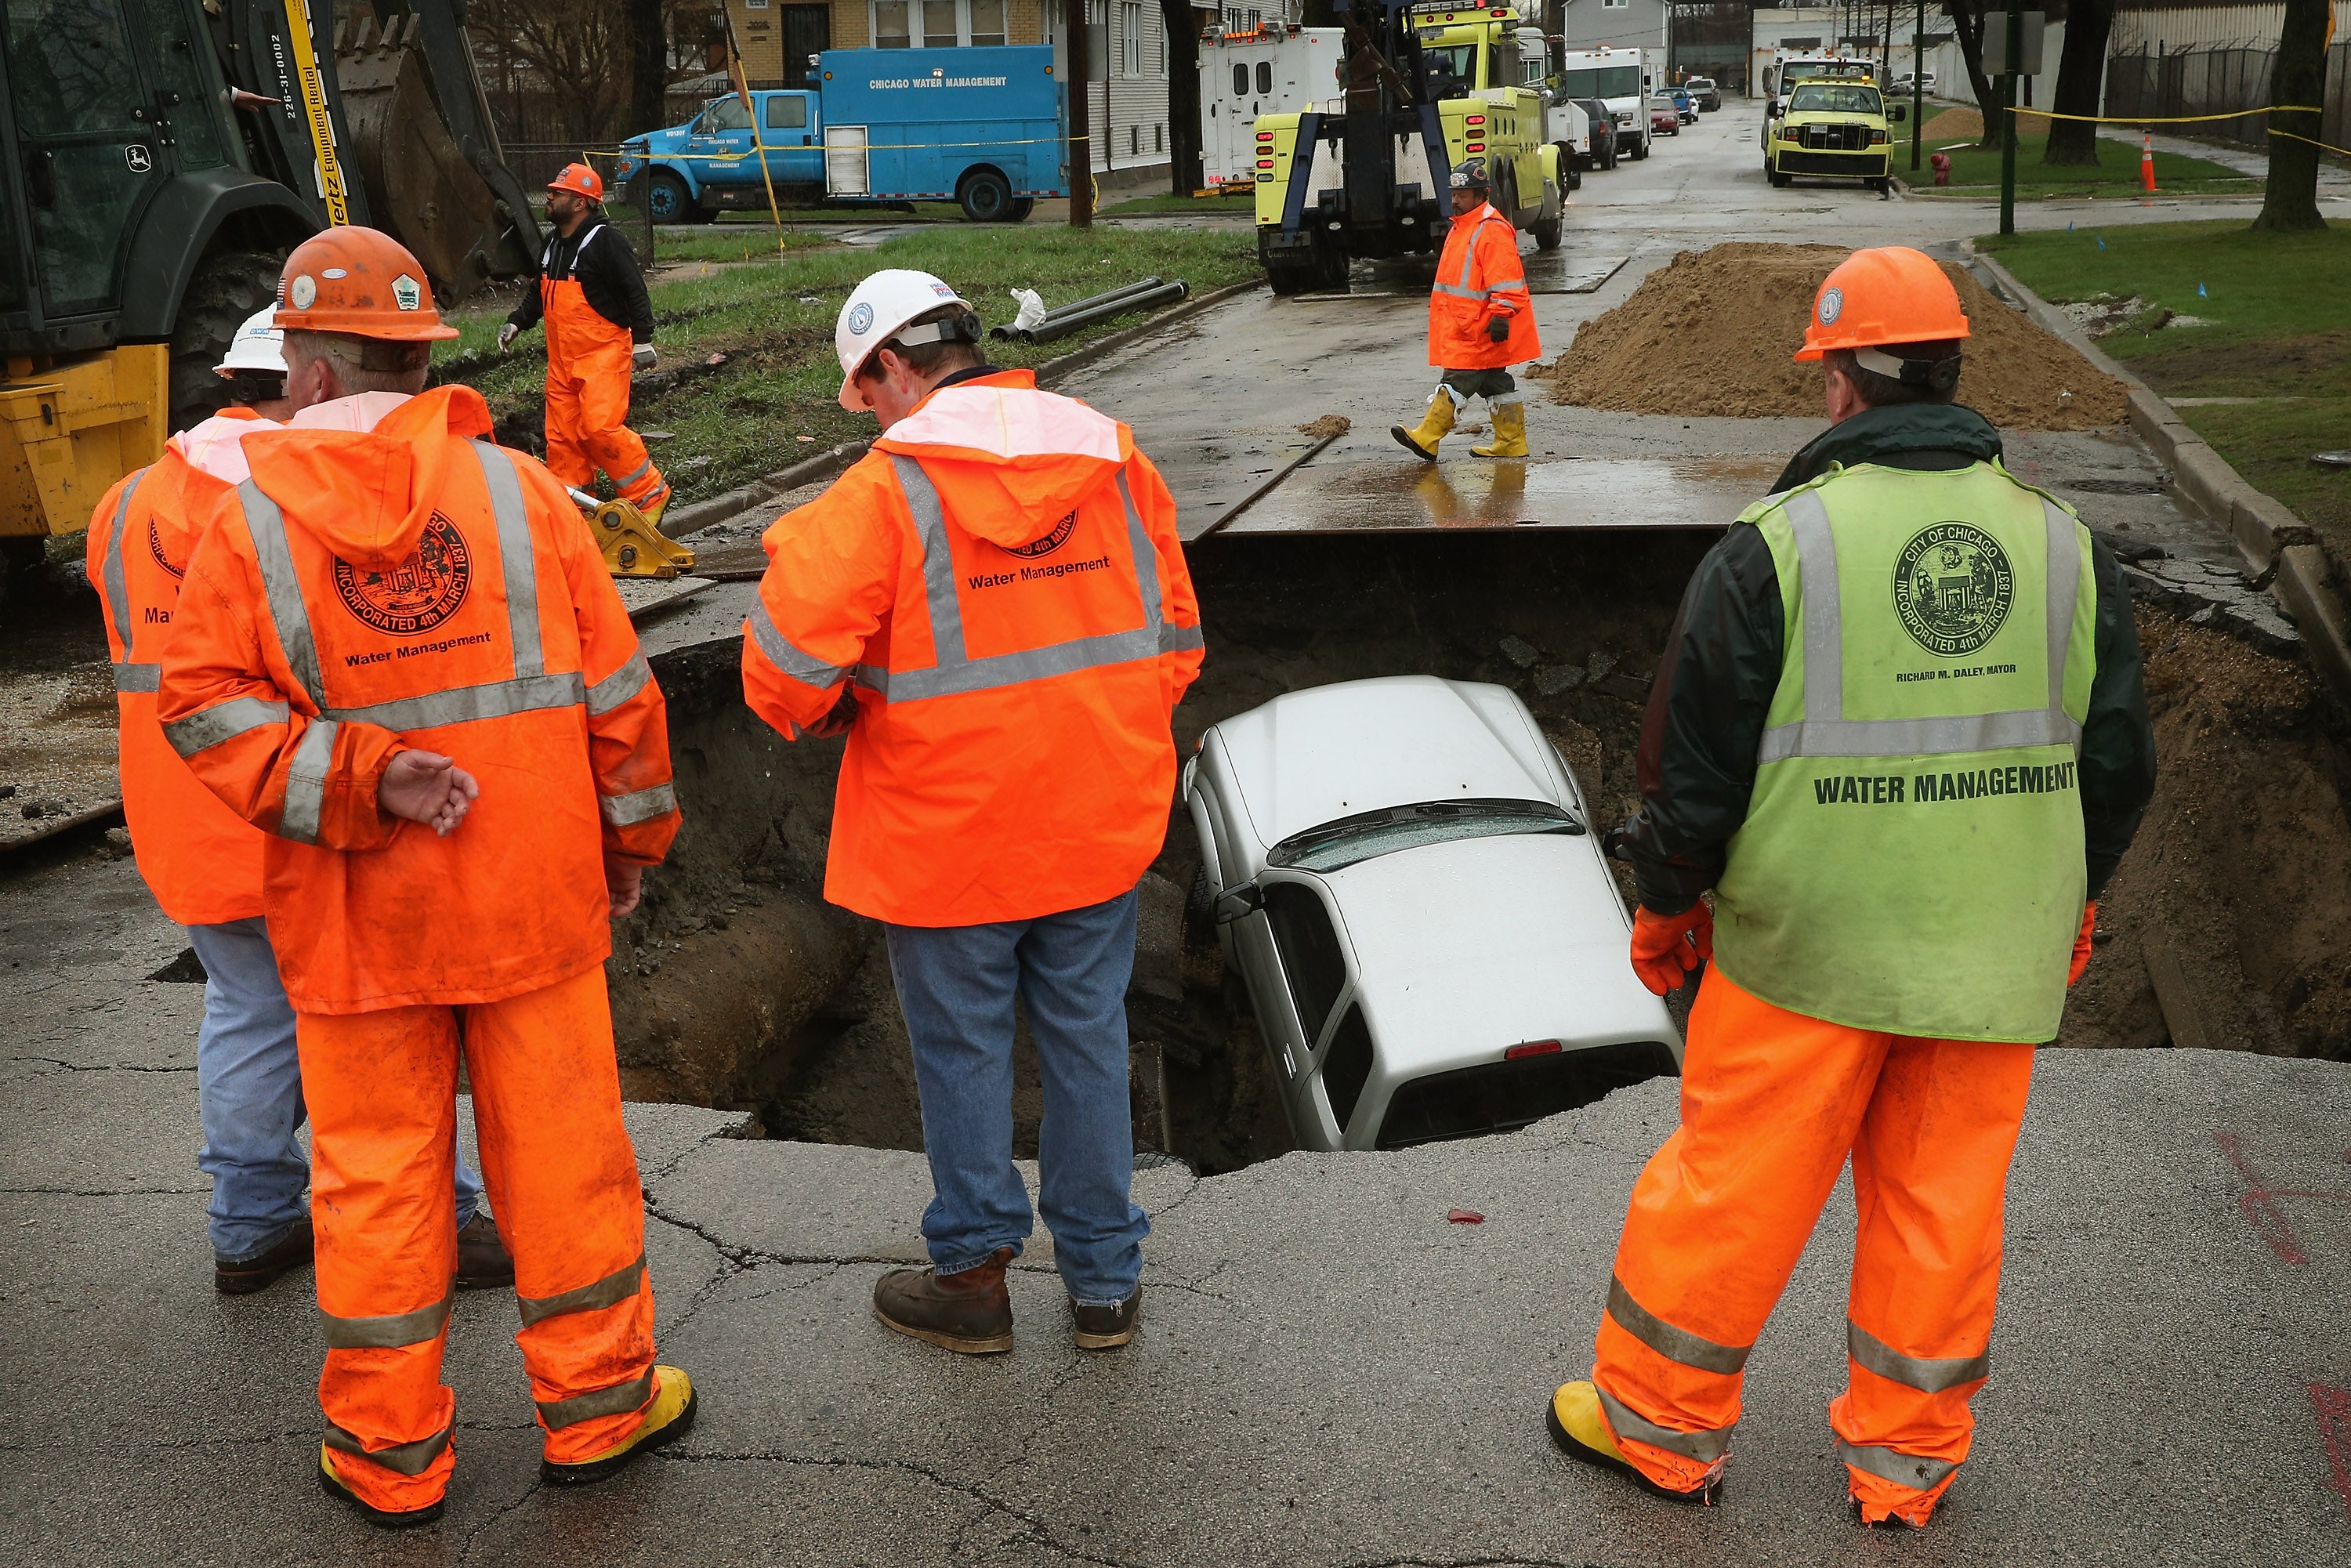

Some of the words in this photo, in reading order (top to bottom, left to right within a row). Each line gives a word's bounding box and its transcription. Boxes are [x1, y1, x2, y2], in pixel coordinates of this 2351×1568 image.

[302, 67, 320, 106] Rental
[869, 78, 910, 89] CHICAGO
[912, 78, 943, 89] WATER
[945, 77, 1007, 88] MANAGEMENT
[312, 107, 335, 172] Equipment
[1034, 540, 1052, 552] 4th
[1051, 512, 1074, 545] MARC
[1905, 536, 1929, 562] CITY
[1929, 527, 1945, 542] OF
[1947, 527, 1998, 558] CHICAGO
[451, 543, 467, 569] 1837
[968, 573, 1016, 590] Water
[1020, 556, 1110, 581] Management
[337, 565, 416, 631] INCORPORATED
[437, 572, 466, 616] MARCH
[1897, 580, 1955, 652] INCORPORATED
[1959, 636, 1979, 650] 4th
[1978, 599, 2007, 641] MARCH
[1998, 570, 2010, 596] 1837
[419, 611, 440, 628] 4th
[345, 651, 392, 668] Water
[397, 632, 491, 660] Management
[1896, 671, 1936, 683] RICHARD
[1938, 670, 1951, 679] M.
[1954, 667, 1985, 679] DALEY,
[1987, 664, 2016, 675] MAYOR
[1813, 776, 1905, 805] WATER
[1914, 761, 2076, 802] MANAGEMENT
